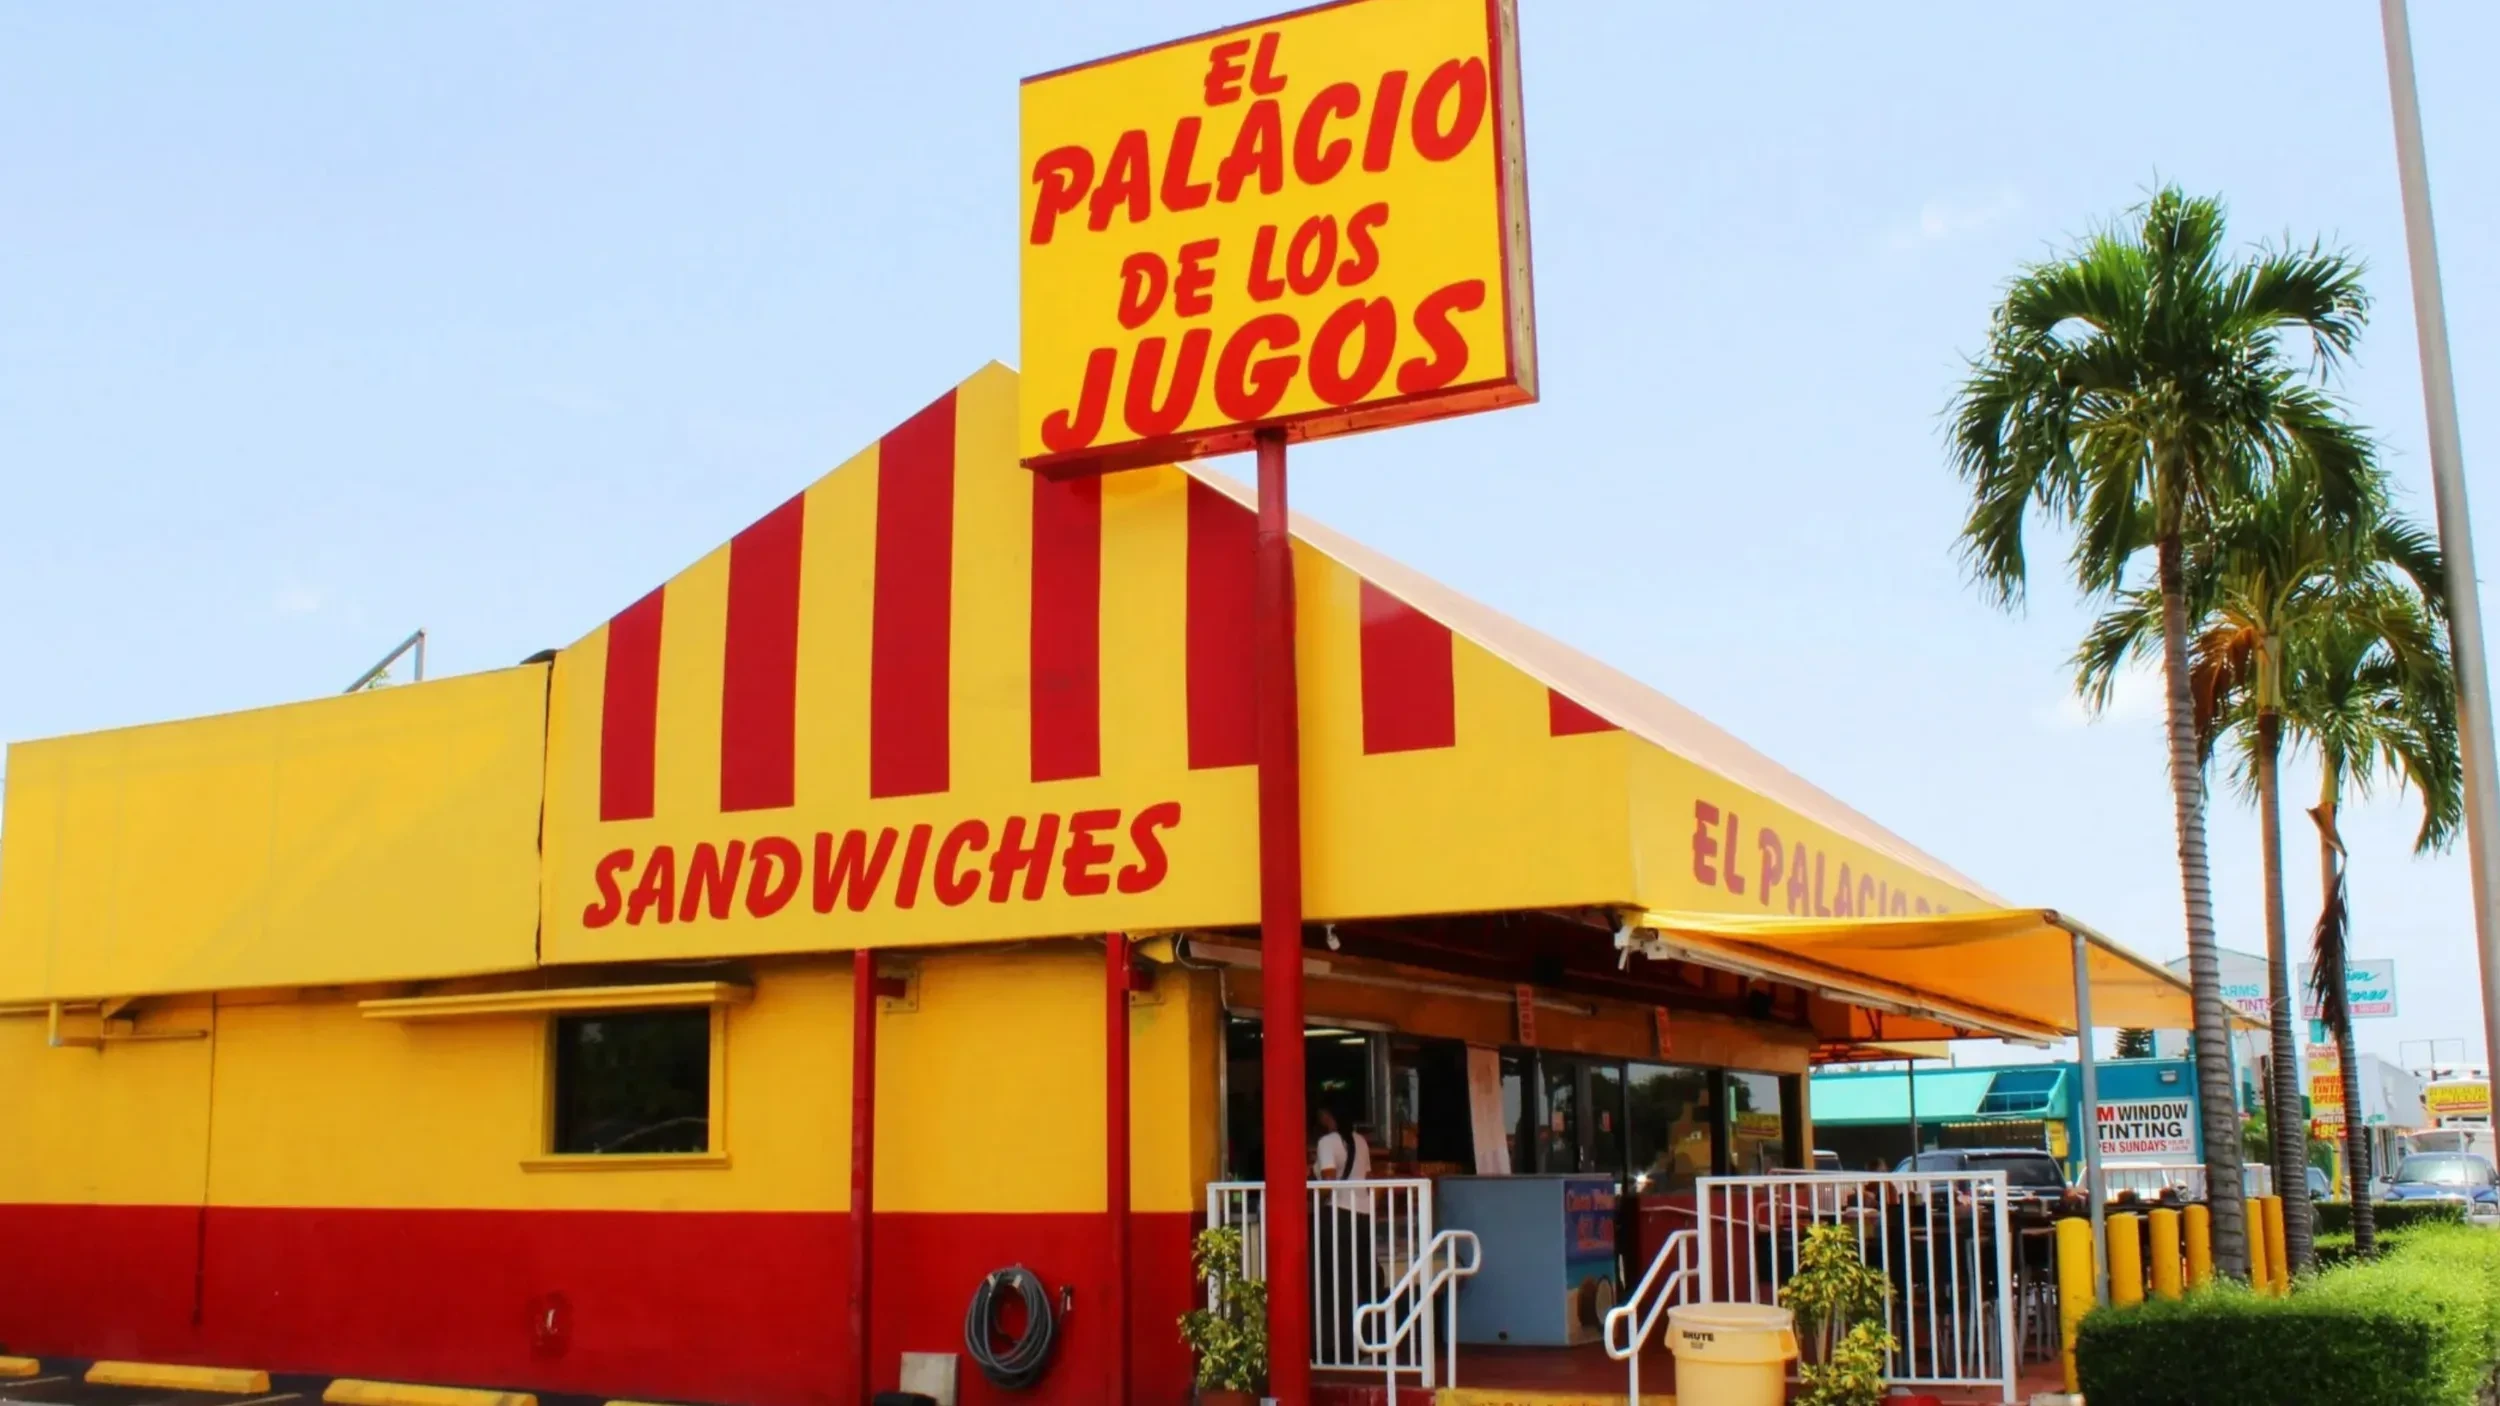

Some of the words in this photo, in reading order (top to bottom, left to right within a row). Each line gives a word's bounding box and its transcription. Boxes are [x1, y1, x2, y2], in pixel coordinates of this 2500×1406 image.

[1204, 31, 1288, 107] EL
[1029, 55, 1488, 245] PALACIO
[1117, 237, 1220, 330] DE
[1247, 201, 1390, 303] LOS
[1041, 278, 1486, 454] JUGOS
[582, 801, 1182, 929] SANDWICHES
[1692, 798, 1745, 896] EL
[2098, 1121, 2182, 1139] TINTING
[2118, 1103, 2188, 1121] WINDOW
[2119, 1139, 2167, 1153] SUNDAYS
